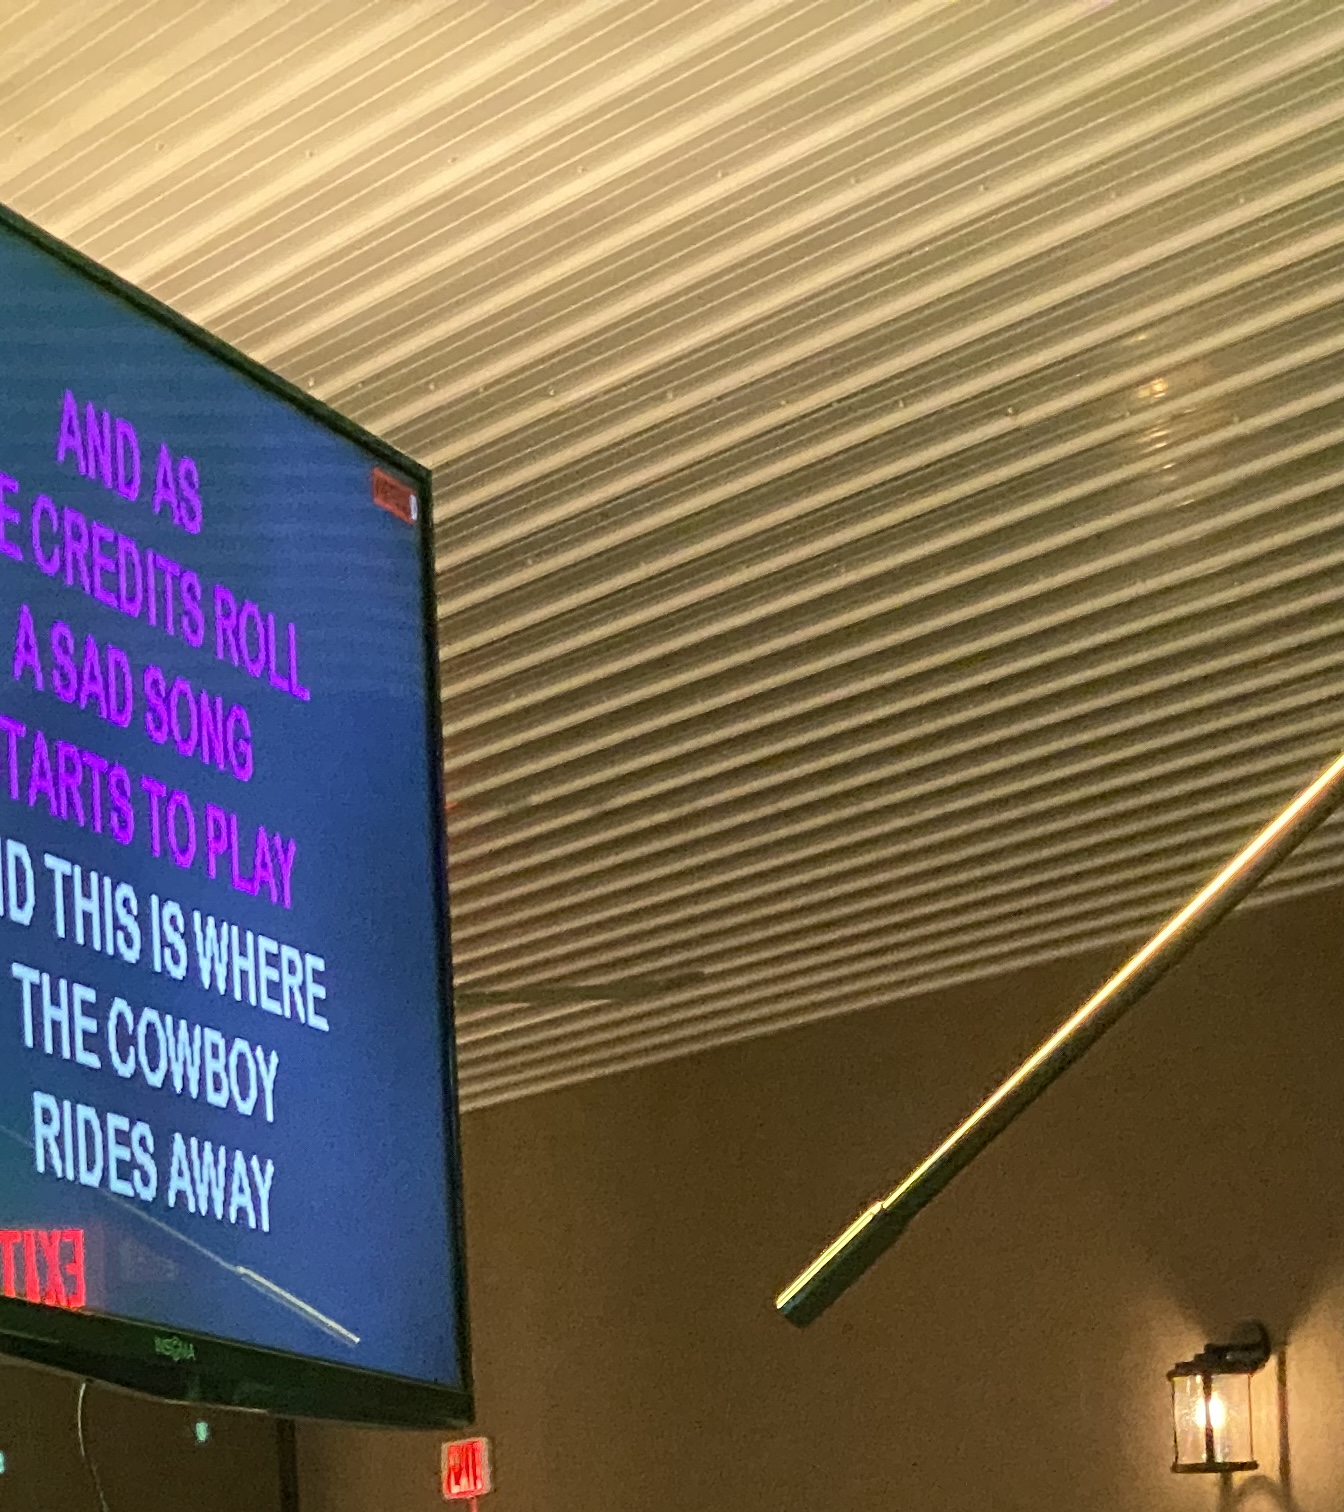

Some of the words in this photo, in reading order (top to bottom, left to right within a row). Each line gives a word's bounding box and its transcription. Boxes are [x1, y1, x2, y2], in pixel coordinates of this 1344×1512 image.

[57, 388, 141, 502] AND
[152, 443, 202, 534] AS
[31, 494, 206, 648] CREDITS
[213, 584, 311, 702] ROLL
[12, 603, 44, 691] A
[50, 619, 134, 728] SAD
[143, 664, 254, 782] SONG
[141, 775, 197, 869] TO
[205, 801, 297, 910] PLAY
[43, 853, 142, 965] THIS
[150, 893, 188, 981] IS
[192, 909, 330, 1032] WHERE
[11, 961, 102, 1071] THE
[107, 996, 279, 1124] COWBOY
[32, 1090, 158, 1202] RIDES
[167, 1131, 275, 1233] AWAY
